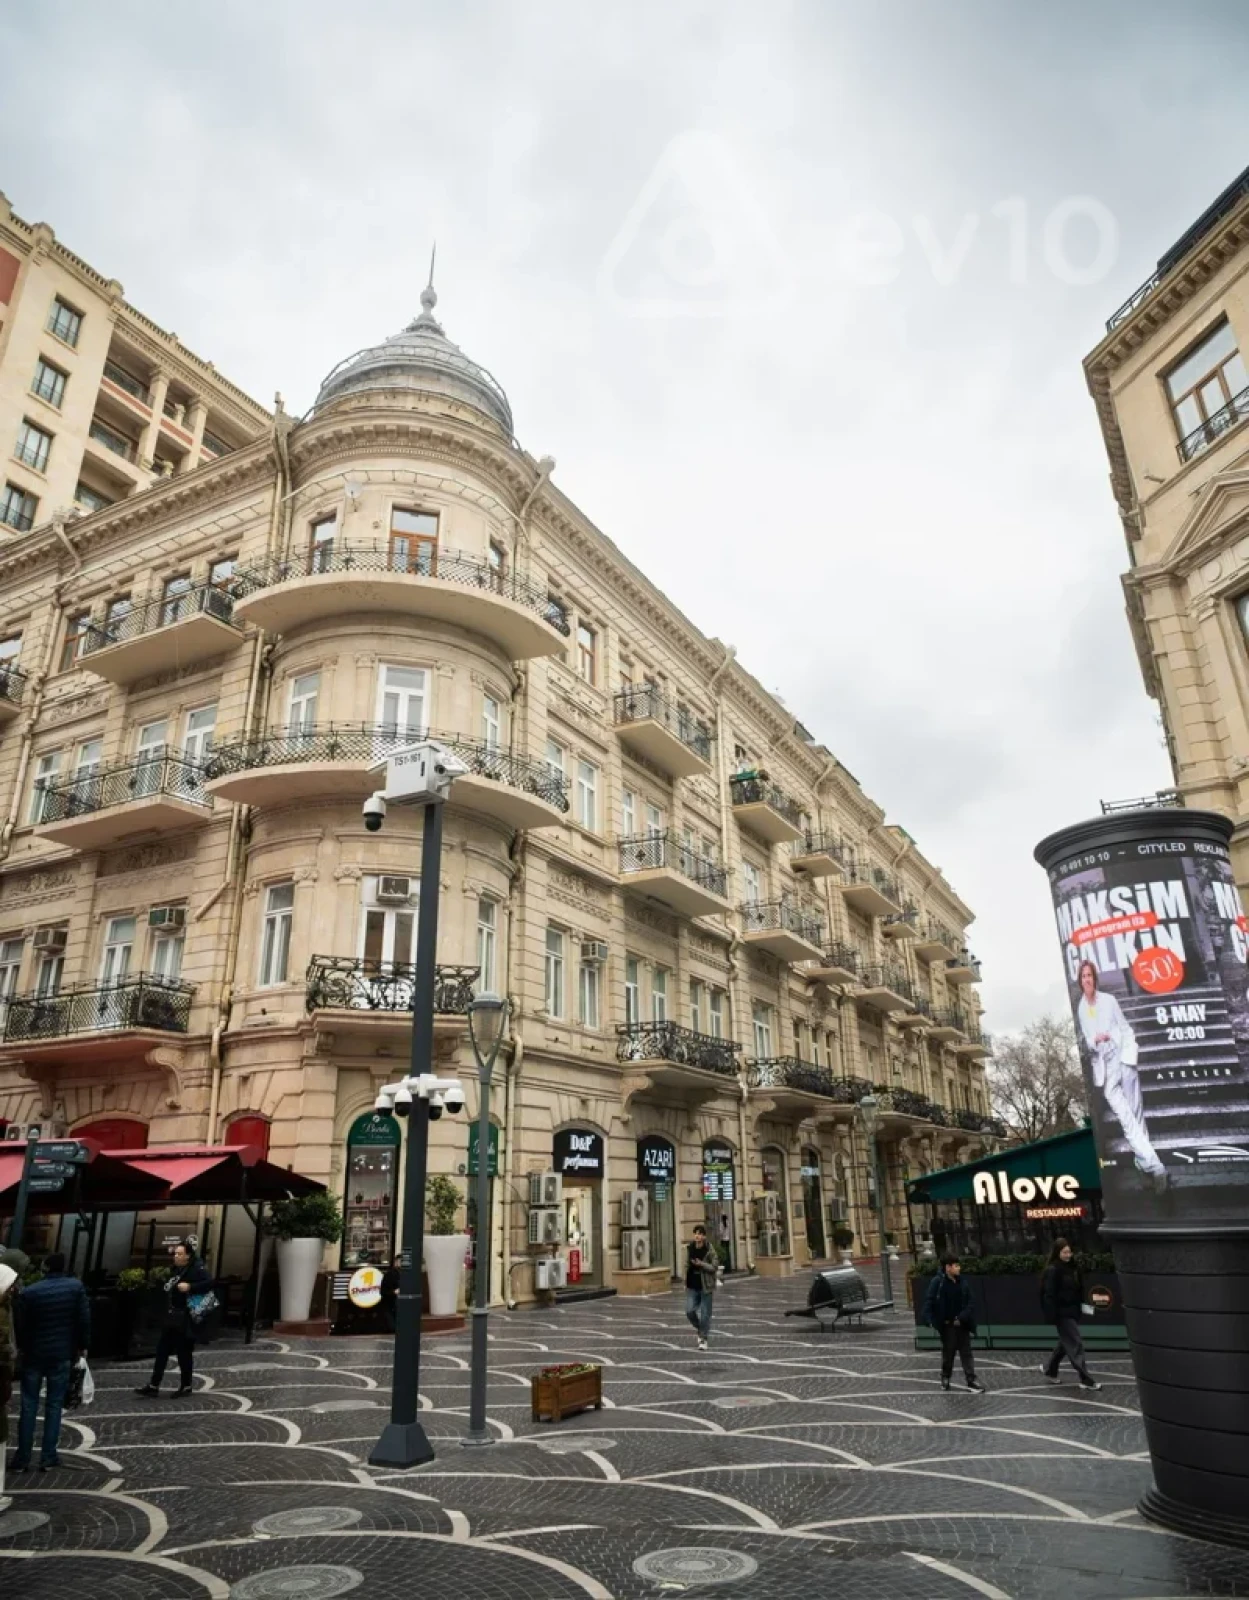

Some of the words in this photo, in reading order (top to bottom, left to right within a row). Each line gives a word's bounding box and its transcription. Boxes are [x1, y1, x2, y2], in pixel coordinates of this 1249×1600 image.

[1097, 851, 1110, 862] 10
[1137, 842, 1186, 855] CITYLED
[1093, 920, 1130, 936] program
[1138, 954, 1179, 986] 50!
[1155, 1006, 1168, 1024] 8
[1170, 1004, 1206, 1023] MAY
[1166, 1025, 1205, 1041] 20:00
[1157, 1068, 1231, 1080] ATELIER
[972, 1171, 1080, 1204] Alove
[1026, 1207, 1083, 1218] RESTAURANT
